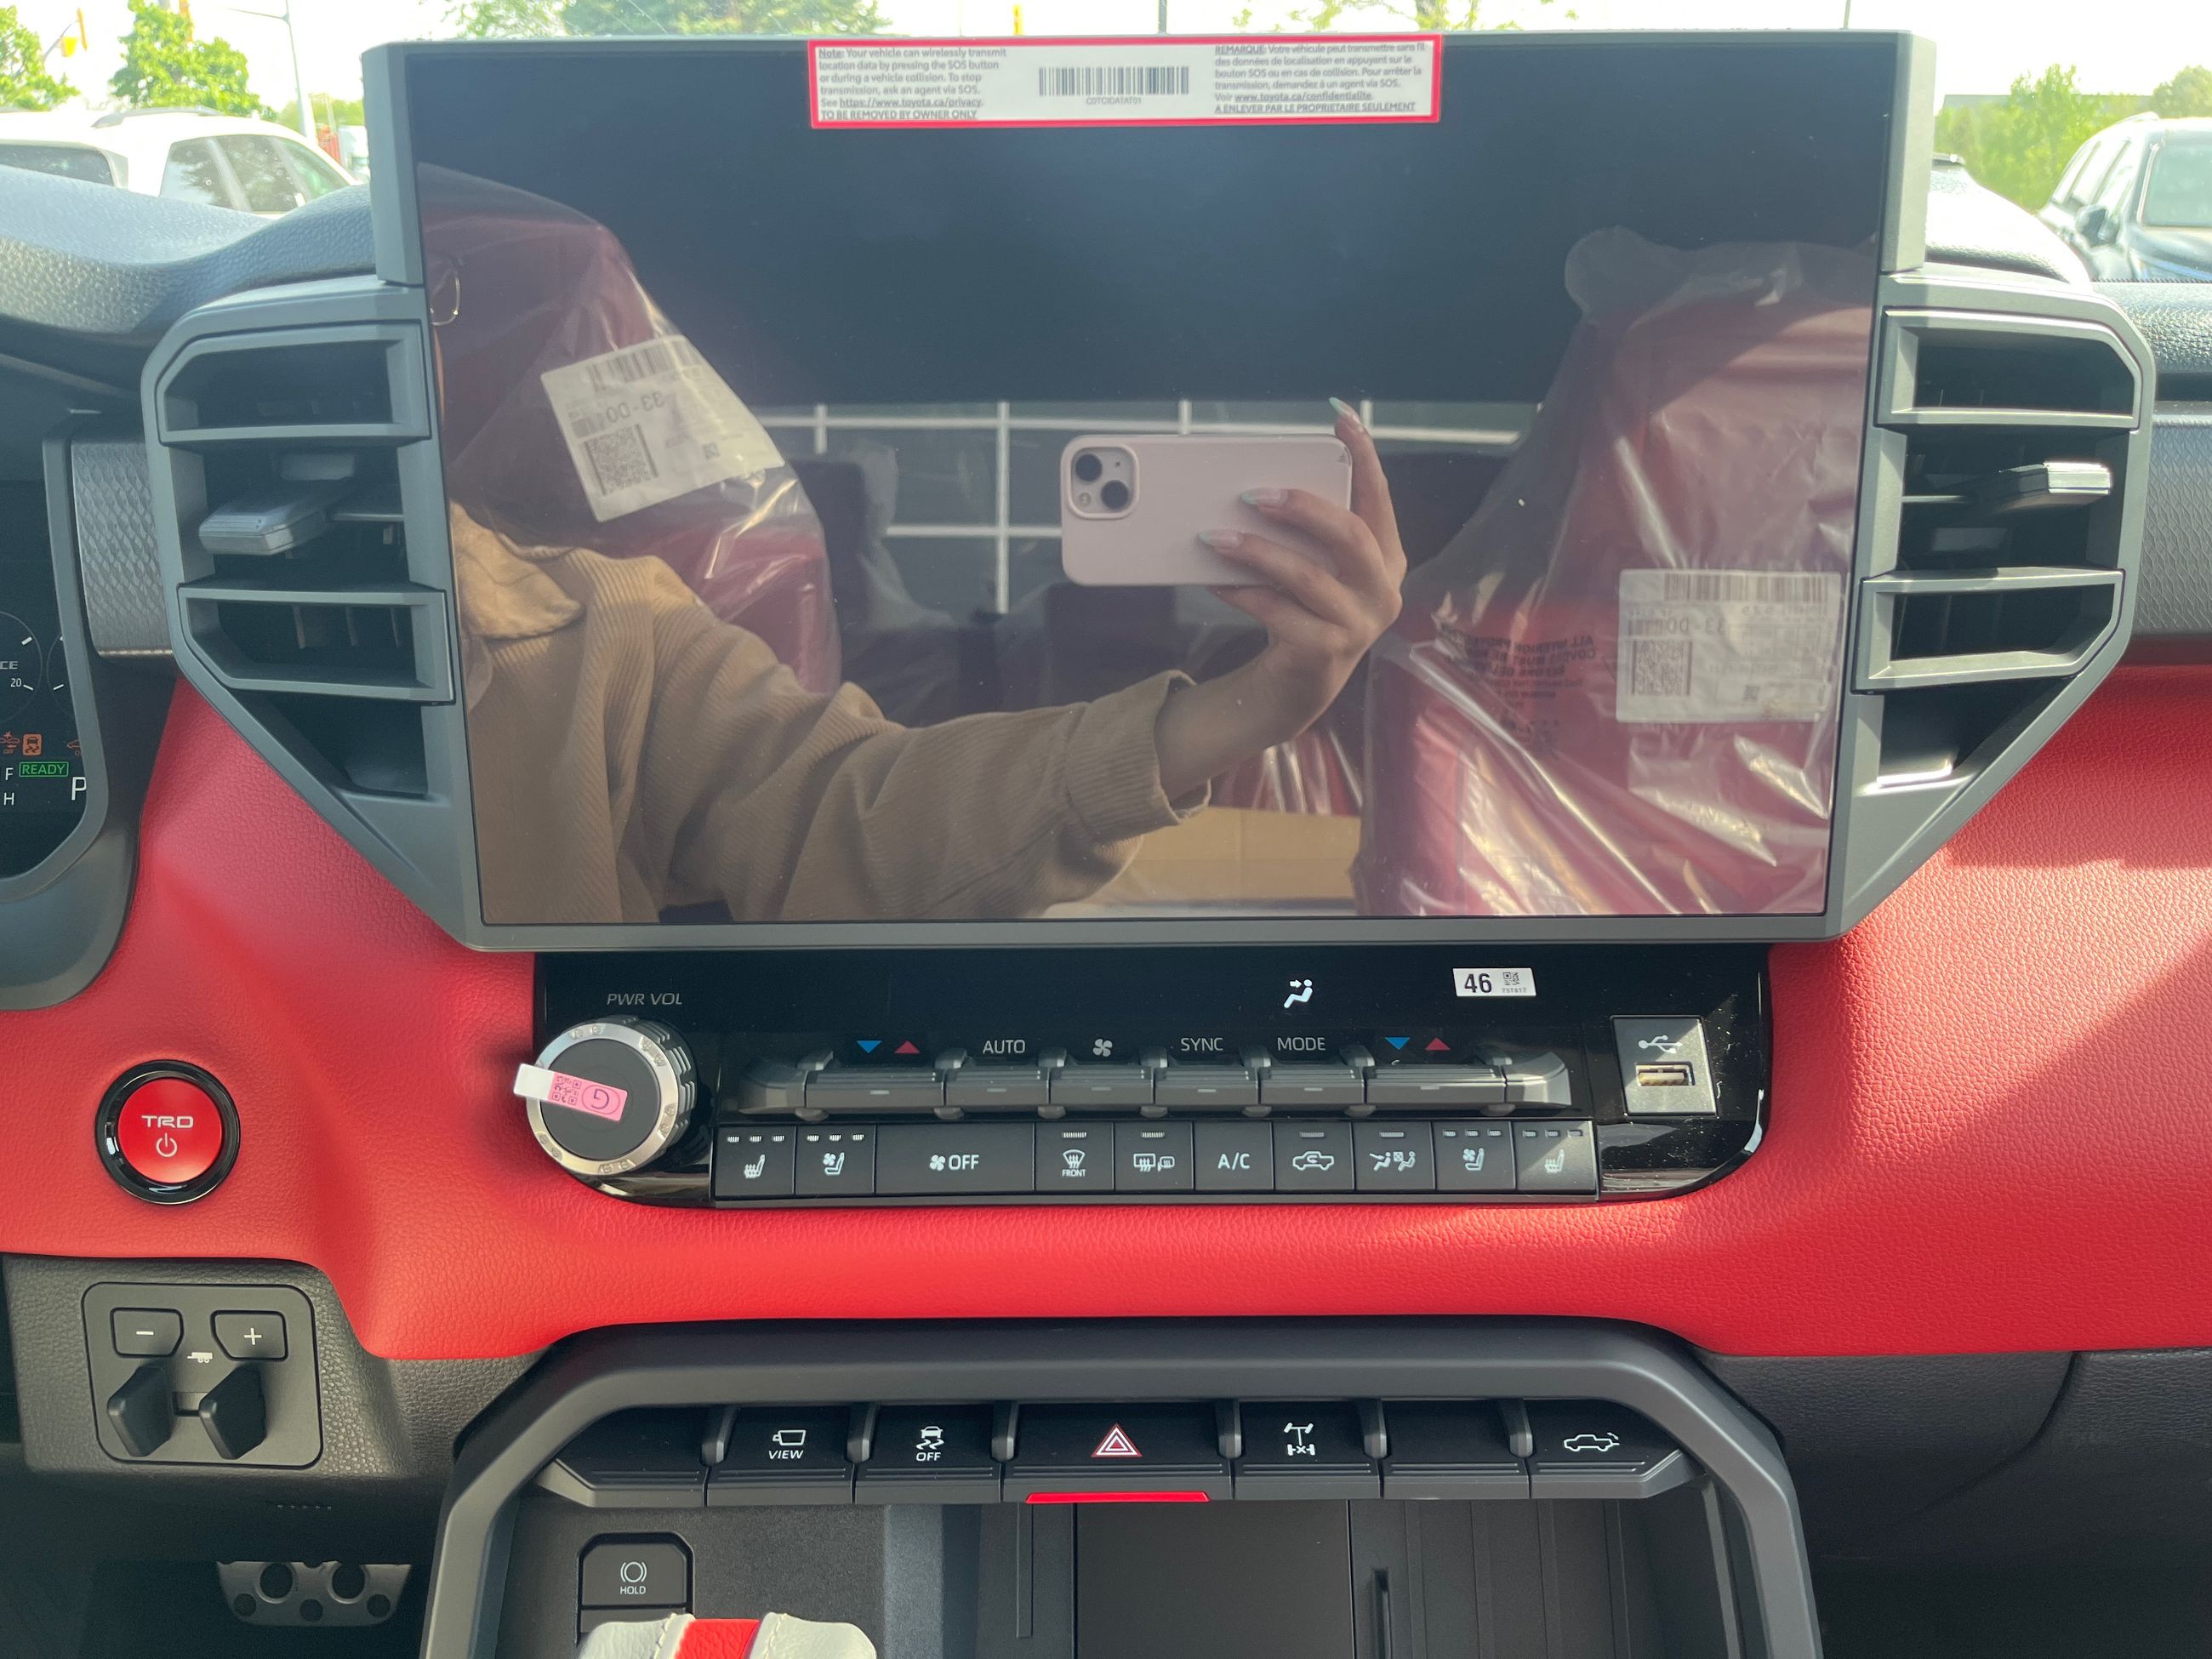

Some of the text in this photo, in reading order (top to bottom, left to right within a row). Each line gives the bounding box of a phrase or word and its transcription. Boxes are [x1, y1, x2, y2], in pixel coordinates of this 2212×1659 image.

[819, 48, 844, 59] Note:
[847, 48, 867, 58] Your
[869, 48, 901, 58] vehicle
[922, 48, 966, 59] wirelessly
[968, 48, 1007, 57] transmit
[1215, 45, 1267, 55] REMARQUE:
[1268, 45, 1291, 54] Votre
[1292, 44, 1325, 53] véhicule
[1326, 45, 1346, 54] peut
[1348, 44, 1395, 53] transmettre
[1417, 43, 1425, 51] fil
[819, 60, 999, 71] location data by pressing the SOS button
[1215, 58, 1230, 66] des
[1232, 57, 1269, 66] données
[1271, 56, 1282, 65] de
[1284, 55, 1332, 65] localisation
[1347, 57, 1387, 66] appuyant
[1404, 54, 1411, 63] le
[831, 73, 861, 84] during
[871, 73, 904, 82] vehicle
[905, 73, 946, 82] collision.
[949, 72, 959, 82] To
[961, 73, 982, 83] stop
[1215, 69, 1246, 78] bouton
[1248, 68, 1267, 77] SOS
[1309, 67, 1321, 77] de
[1322, 67, 1359, 77] collision.
[1362, 67, 1382, 76] Pour
[1383, 67, 1412, 76] arrêter
[1413, 66, 1422, 75] la
[1215, 80, 1271, 90] transmission,
[1272, 79, 1318, 88] demandez
[1320, 79, 1325, 88] à
[1339, 80, 1365, 90] agent
[1365, 79, 1378, 88] via
[1380, 78, 1401, 88] SOS.
[820, 86, 881, 95] transmission,
[883, 85, 898, 94] ask
[914, 86, 941, 96] agent
[943, 85, 956, 94] via
[958, 85, 980, 94] SOS.
[821, 97, 983, 109] See https://www.toyota.ca/privacy.
[1215, 102, 1416, 114] A ENLEVER PAR LE PROPRIETAIRE SEULEMENT
[821, 110, 977, 120] TO BE REMOVED BY OWNER ONLY
[10, 678, 22, 687] 20
[5, 767, 14, 781] F
[21, 764, 66, 775] READY
[71, 777, 87, 801] P
[3, 792, 14, 806] H
[1464, 972, 1492, 994] 46
[607, 993, 682, 1006] PWR VOL
[983, 1039, 1026, 1055] AUTO
[1180, 1037, 1223, 1052] SYNC
[1277, 1036, 1326, 1052] MODE
[141, 1115, 194, 1129] TRD
[948, 1154, 979, 1171] OFF
[1217, 1152, 1251, 1171] A/C
[1062, 1169, 1086, 1177] FRONT
[768, 1450, 804, 1460] VIEW
[915, 1451, 942, 1462] OFF
[619, 1586, 647, 1595] HOLD
